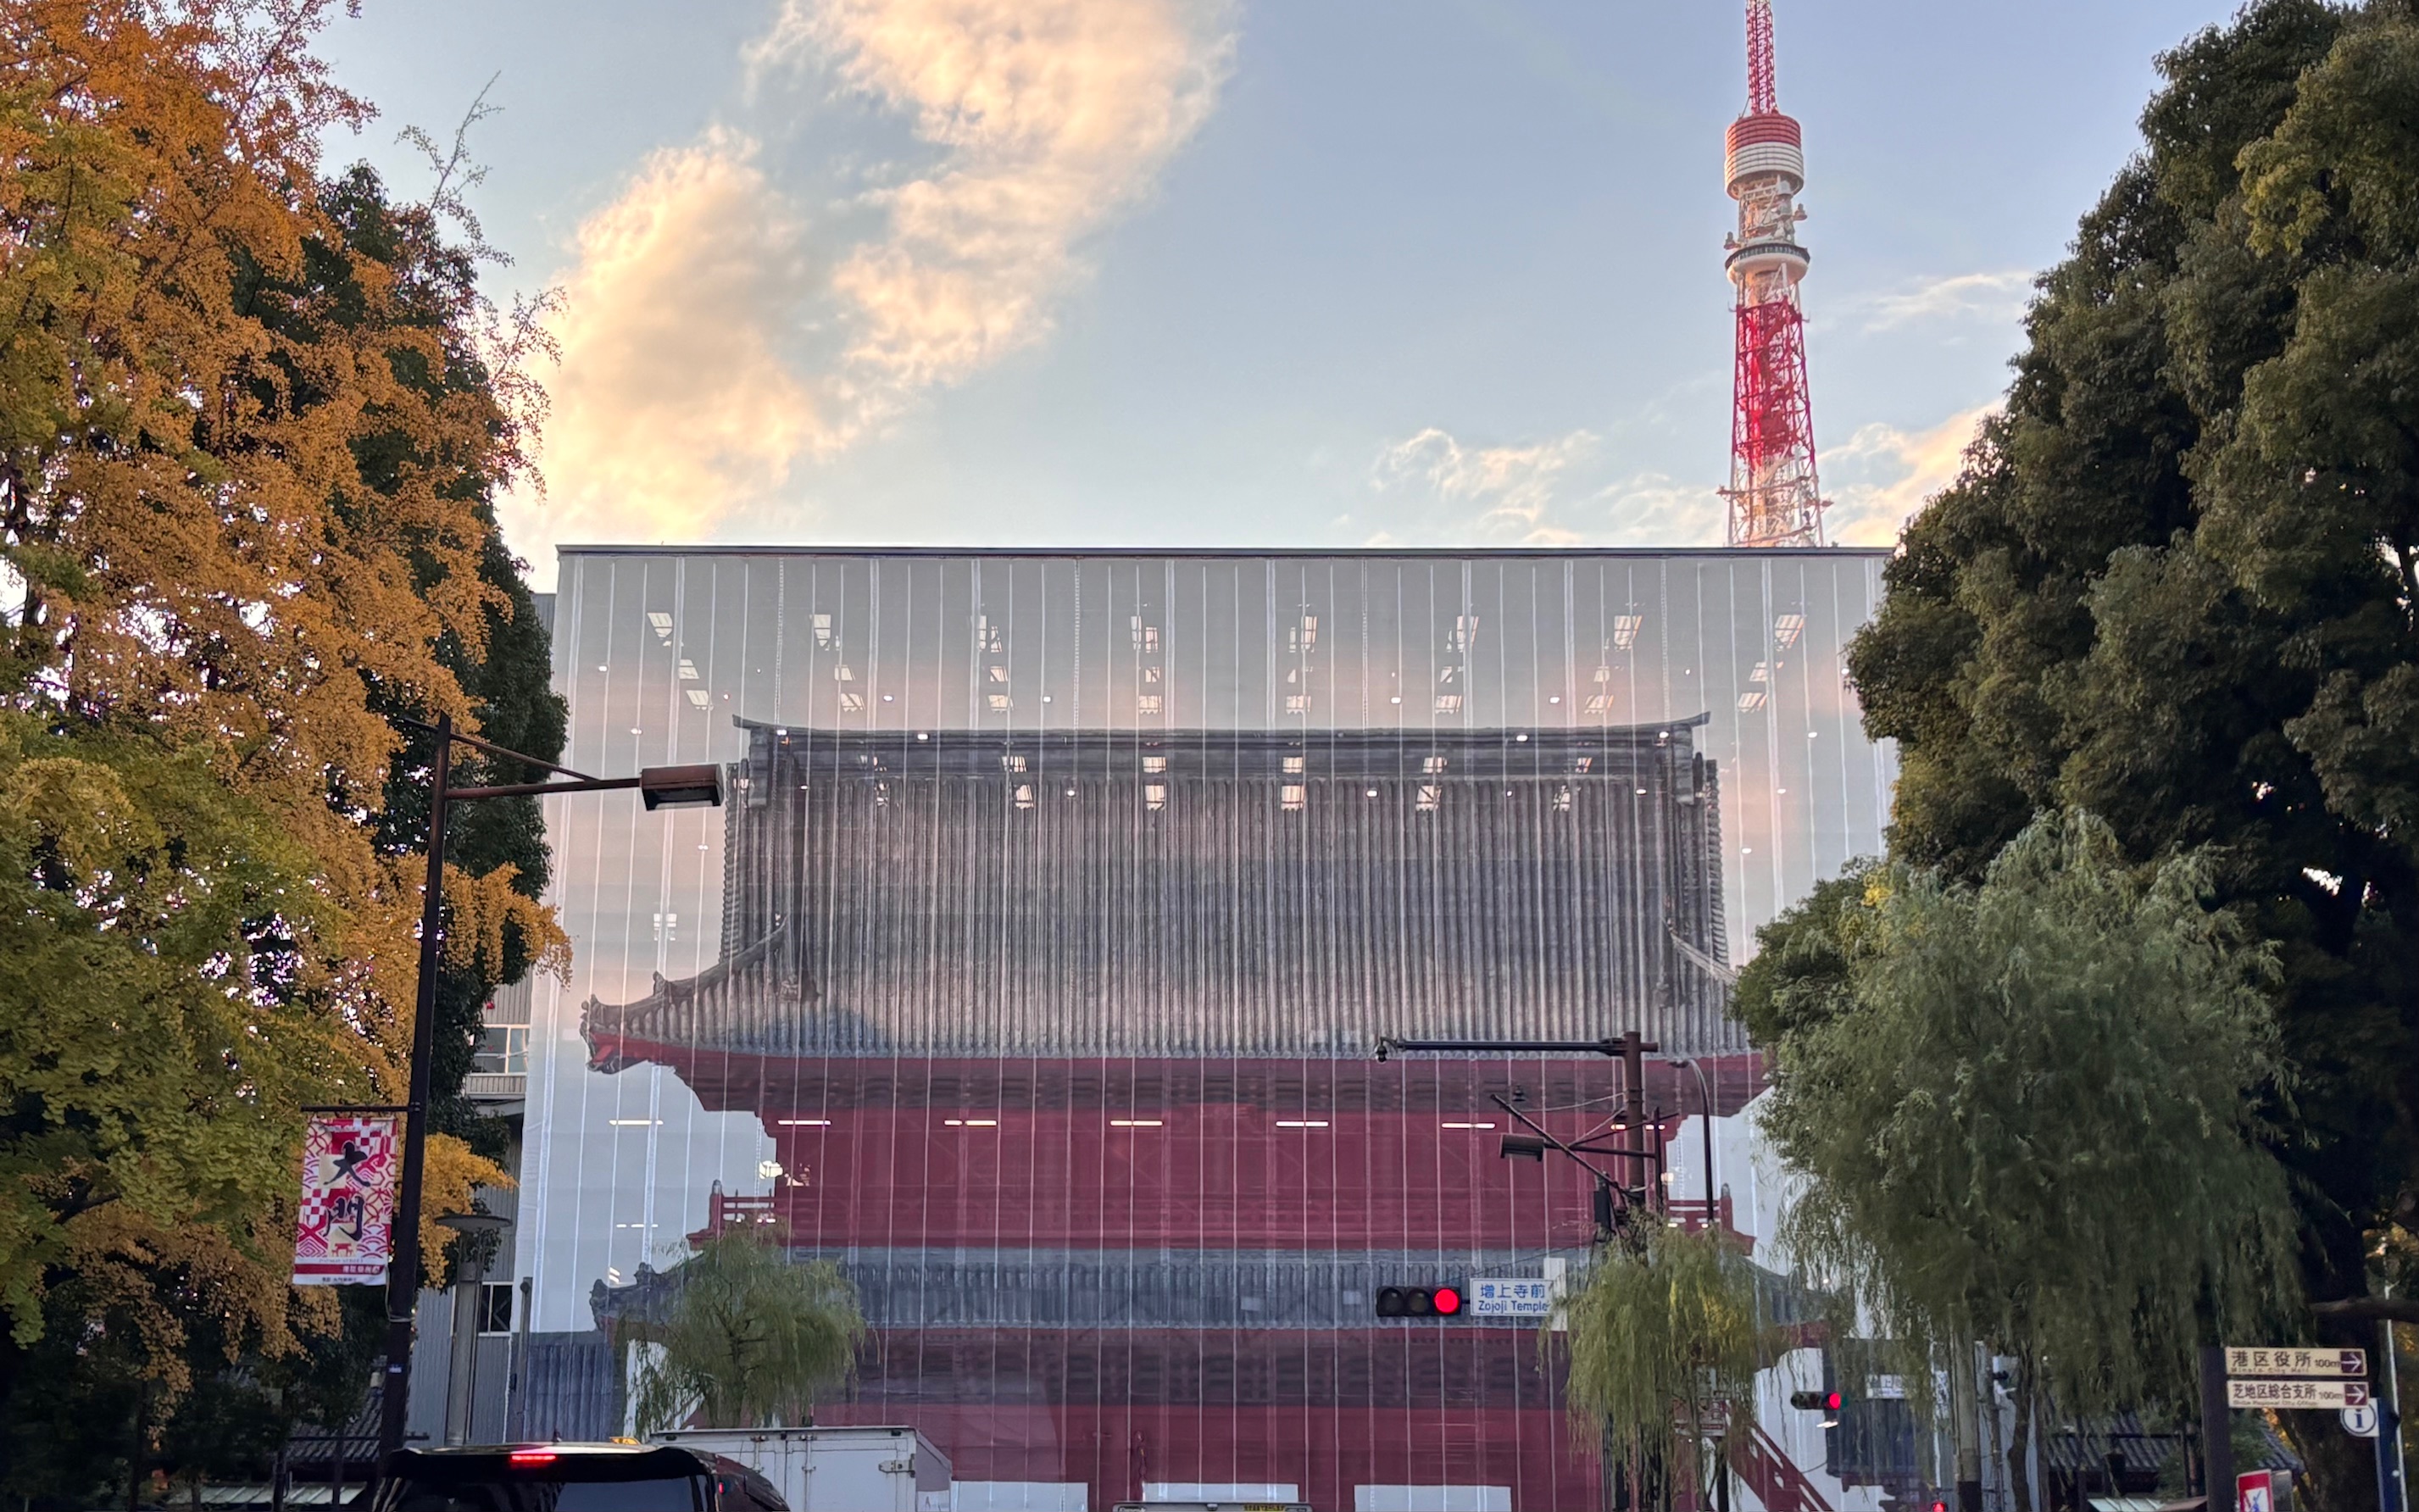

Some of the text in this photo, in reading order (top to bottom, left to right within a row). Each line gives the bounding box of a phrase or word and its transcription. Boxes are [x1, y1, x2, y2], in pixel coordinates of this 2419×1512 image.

[323, 1141, 371, 1241] 大門
[1480, 1283, 1545, 1298] 増上寺前
[1478, 1299, 1548, 1314] Zojoji Temple
[2232, 1351, 2340, 1368] 港区役所 100m
[2233, 1383, 2343, 1399] 芝地区総合支所 100m
